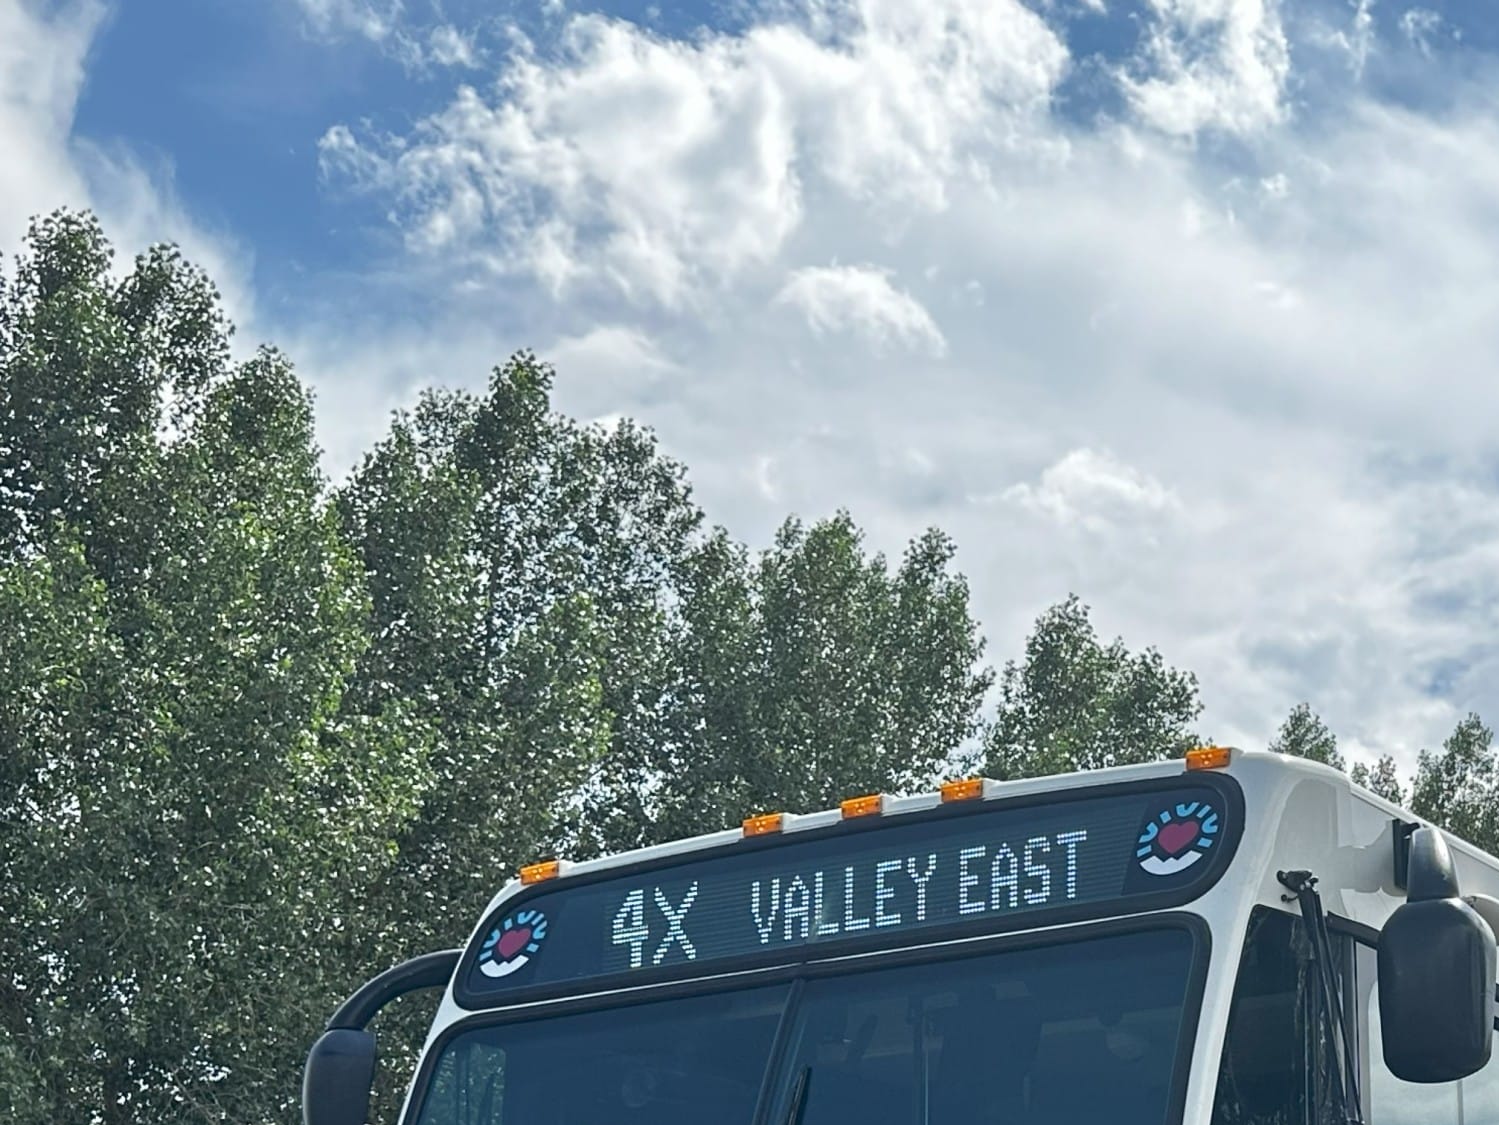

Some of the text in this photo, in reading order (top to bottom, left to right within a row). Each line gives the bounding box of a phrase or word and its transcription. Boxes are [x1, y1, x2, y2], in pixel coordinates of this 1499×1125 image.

[612, 830, 1087, 968] 4X VALLEY EAST
